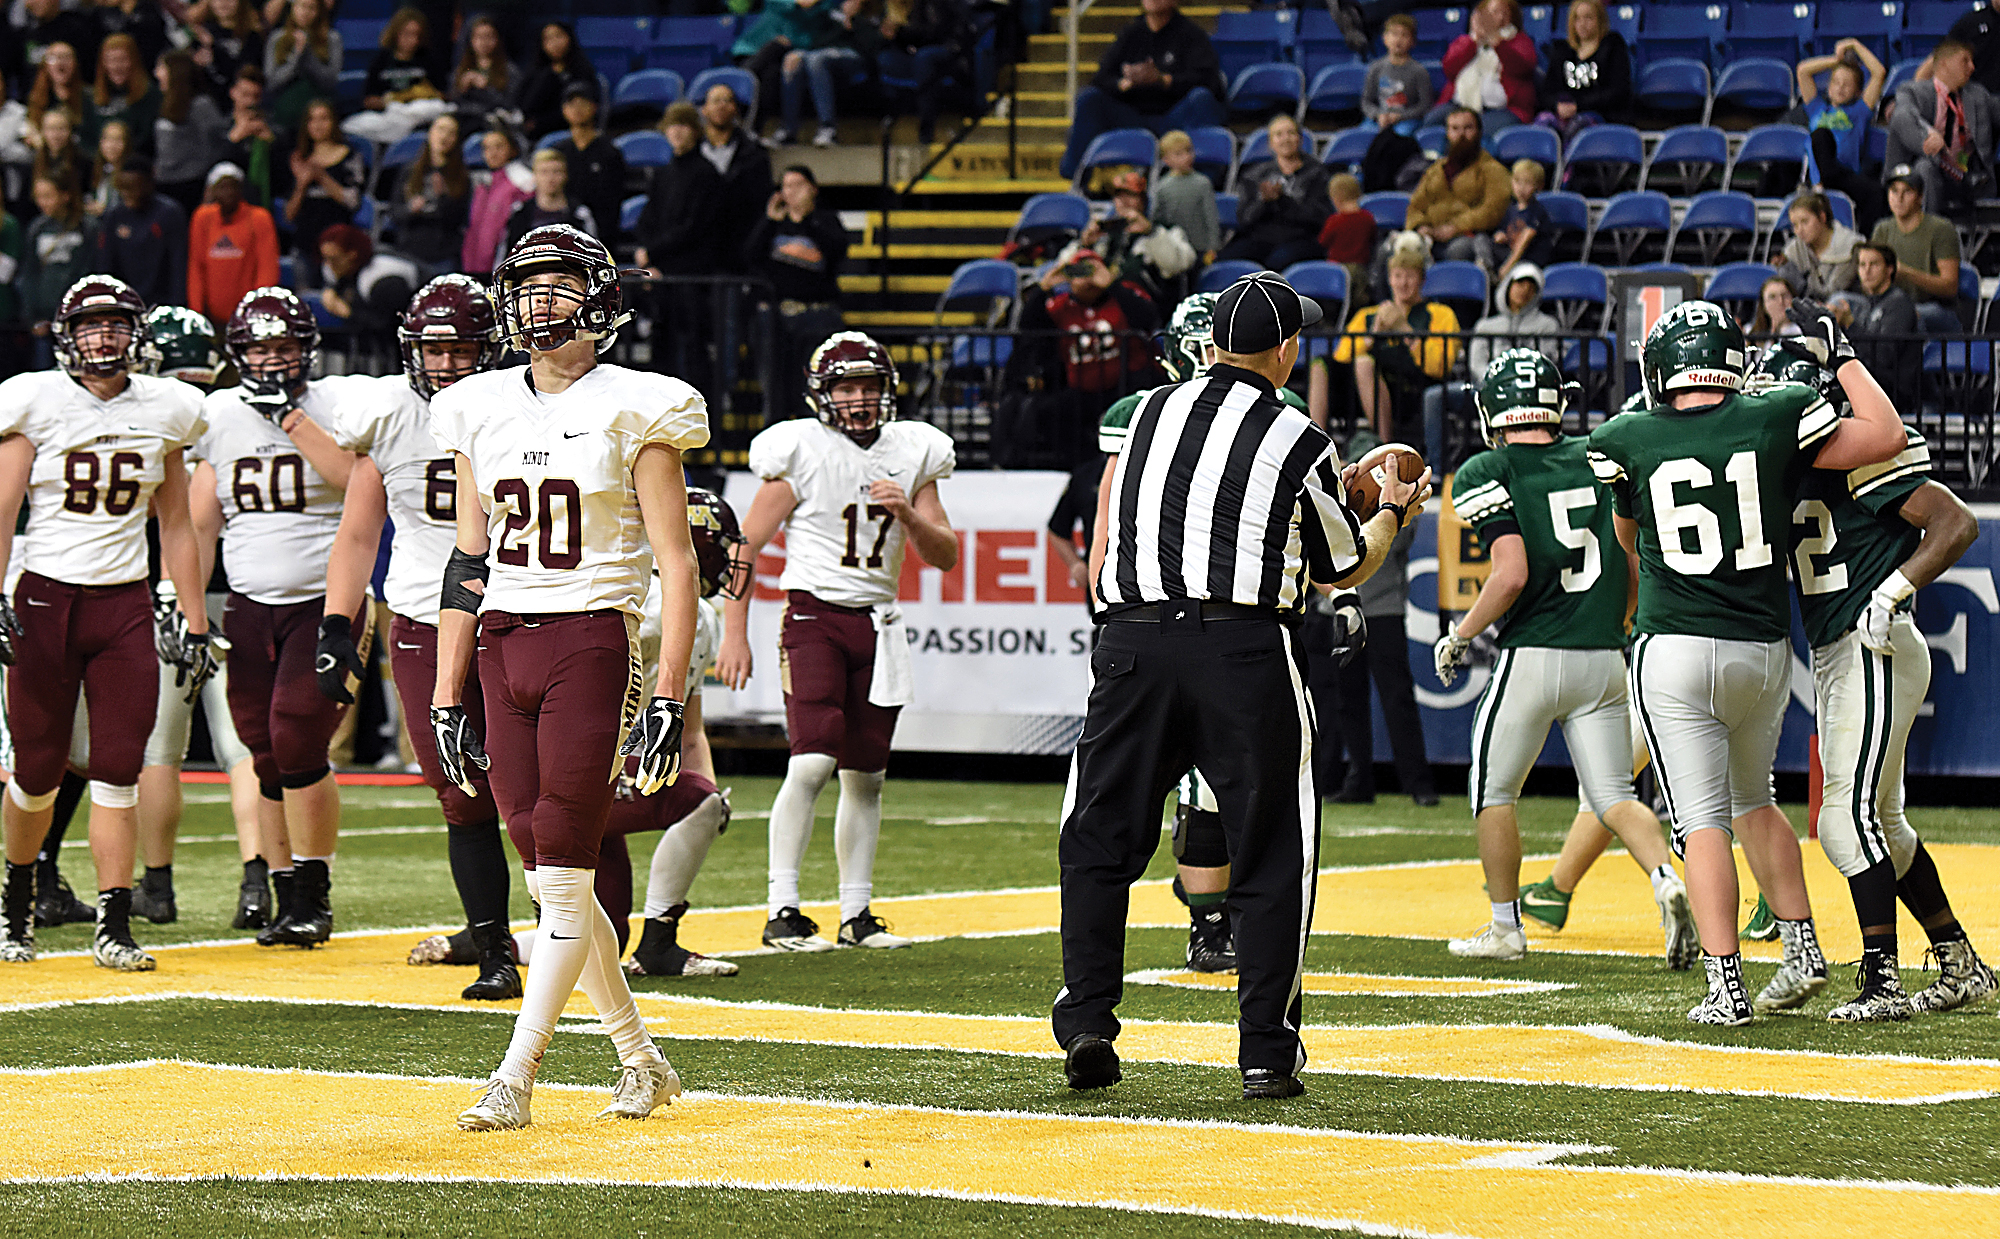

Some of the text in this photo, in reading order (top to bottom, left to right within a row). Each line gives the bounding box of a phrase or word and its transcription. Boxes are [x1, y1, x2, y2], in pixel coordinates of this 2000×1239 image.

[1514, 361, 1536, 388] 5
[1688, 373, 1736, 386] Riddell
[1505, 411, 1550, 424] Riddell
[64, 452, 144, 516] 86
[233, 454, 306, 513] 60
[522, 451, 549, 466] MINOT
[493, 477, 583, 570] 20
[841, 503, 896, 568] 17
[1548, 486, 1602, 593] 5
[1649, 450, 1772, 575] 61
[906, 628, 1056, 655] PASSION.
[624, 655, 642, 728] MINOT
[1723, 957, 1747, 1012] UNDER
